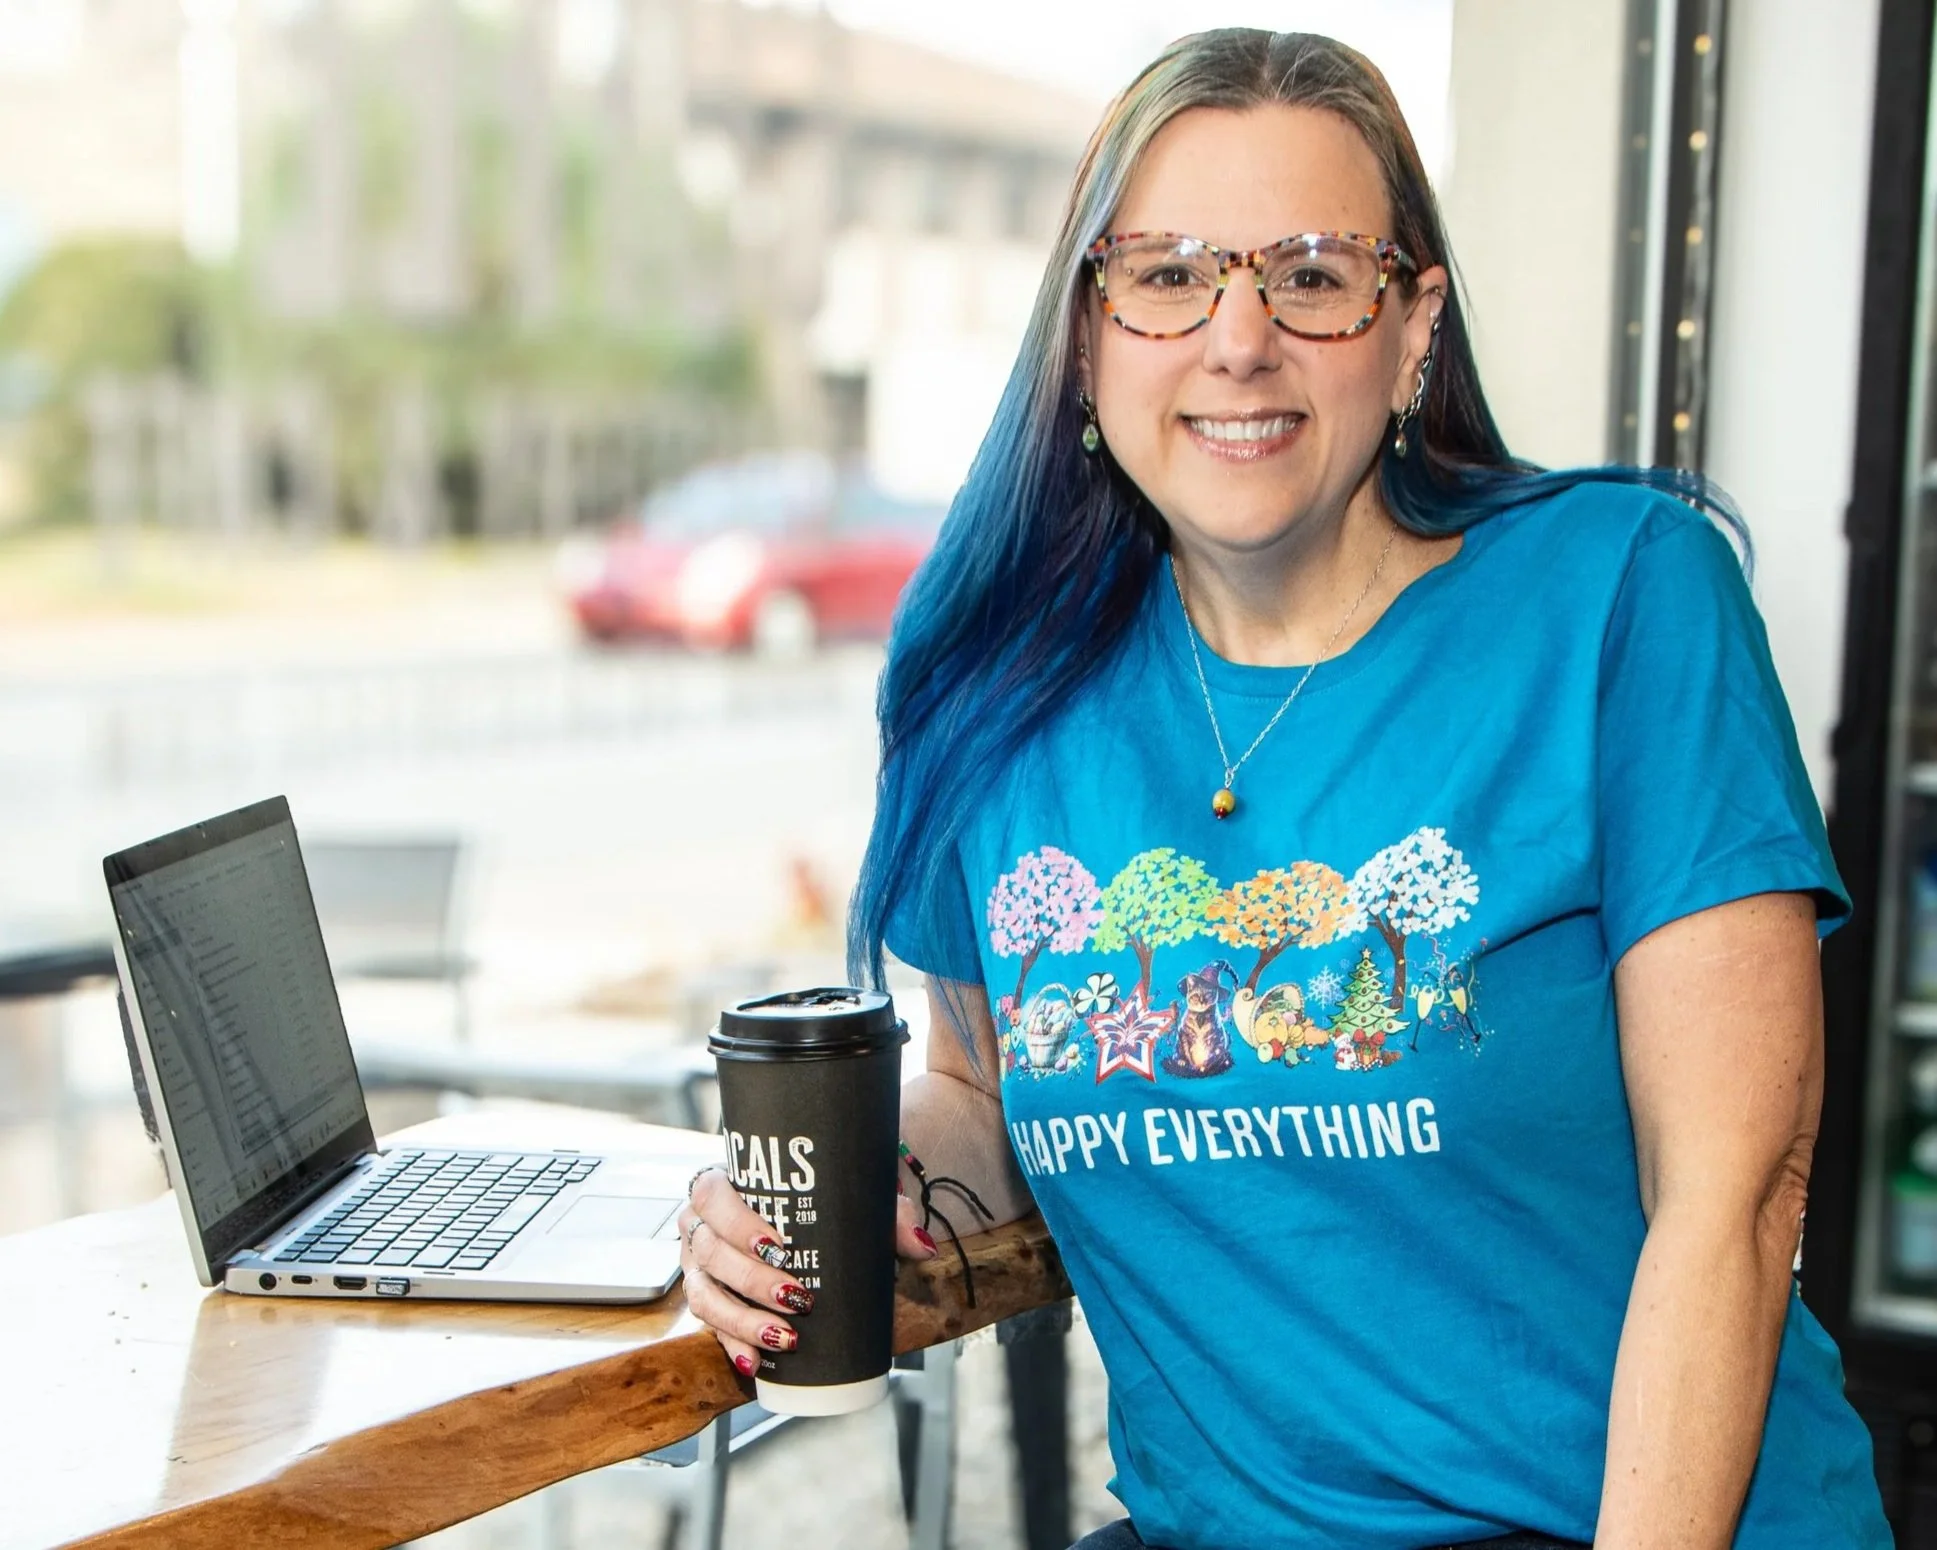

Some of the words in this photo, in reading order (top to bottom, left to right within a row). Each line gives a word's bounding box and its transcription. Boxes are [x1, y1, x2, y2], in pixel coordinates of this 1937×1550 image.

[1012, 1111, 1130, 1176] HAPPY
[1144, 1097, 1441, 1166] EVERYTHING
[797, 1197, 813, 1209] EST
[795, 1210, 817, 1222] 2018
[785, 1249, 820, 1269] CAFE
